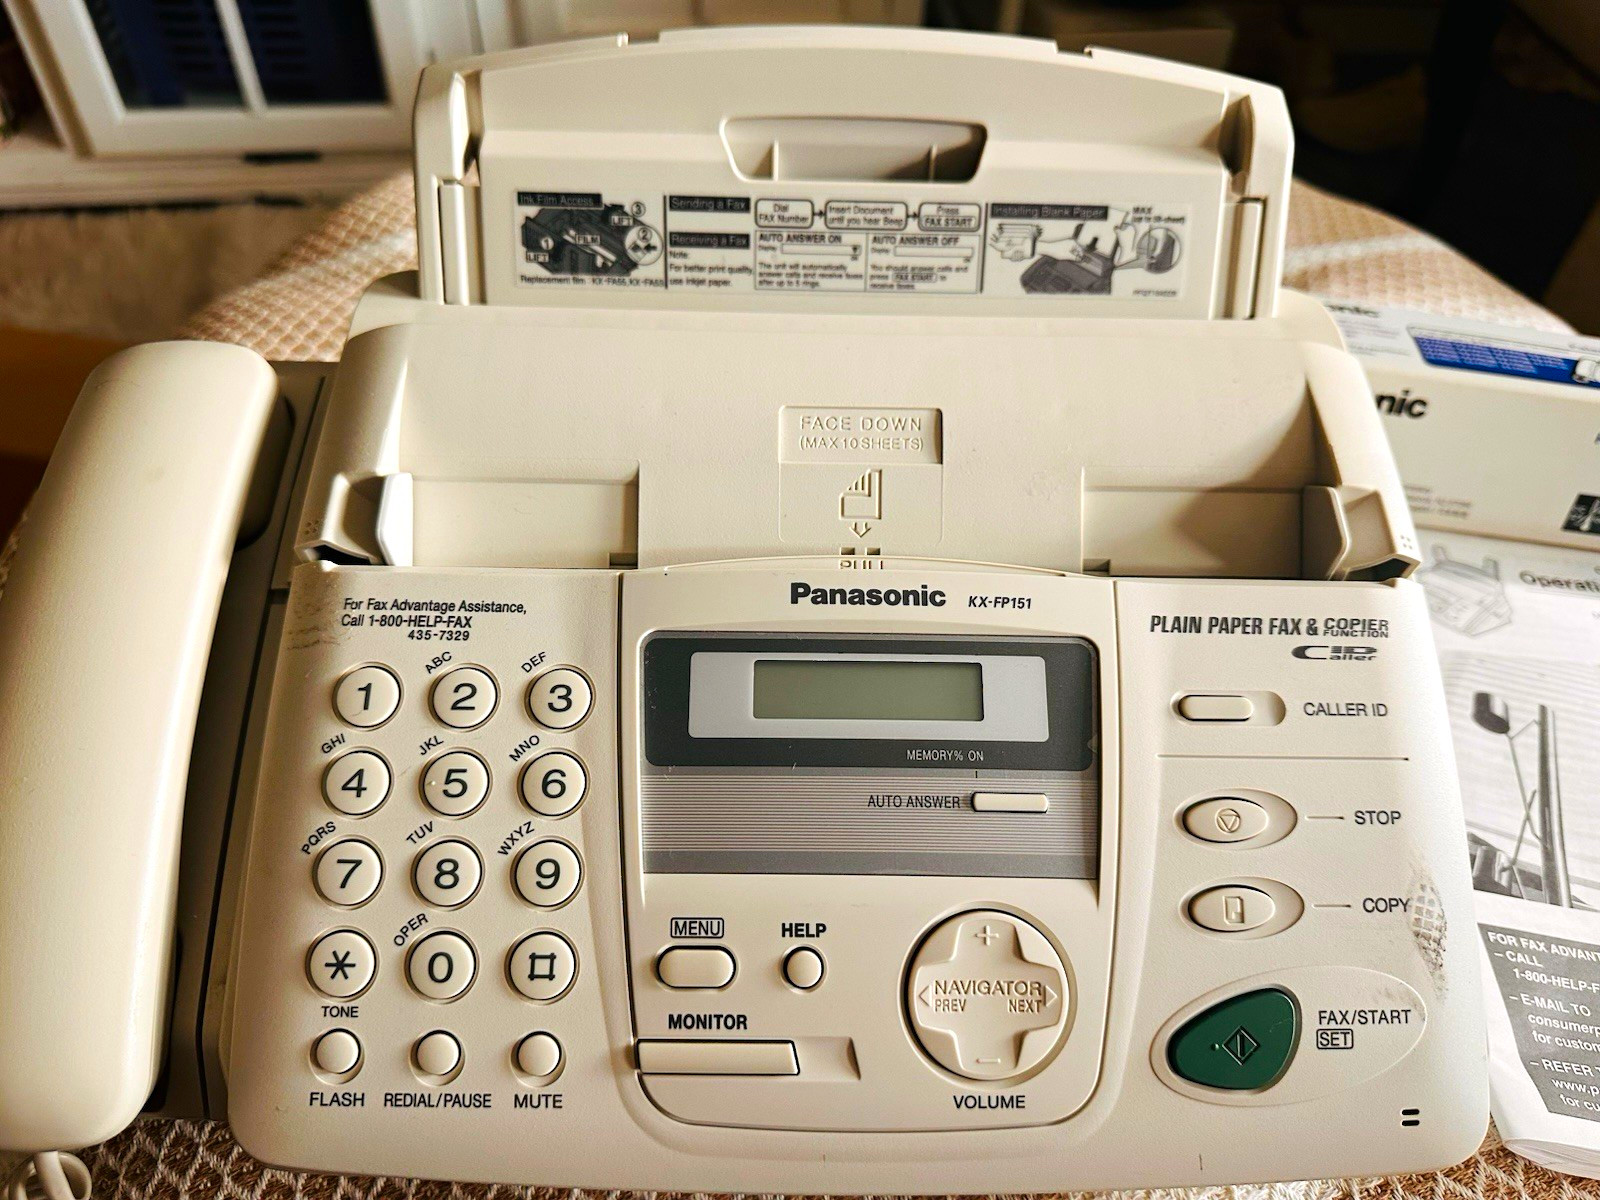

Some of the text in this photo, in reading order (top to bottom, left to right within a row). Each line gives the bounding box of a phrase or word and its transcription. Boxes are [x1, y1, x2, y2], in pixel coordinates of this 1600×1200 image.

[671, 198, 715, 211] Sending
[727, 200, 746, 209] Fax
[773, 203, 790, 212] Dial
[828, 206, 894, 215] Insert Document
[936, 206, 960, 215] Press
[611, 216, 633, 226] LIFT
[759, 214, 809, 223] FAX Number
[994, 206, 1039, 219] Installing
[1073, 207, 1106, 220] Paper
[828, 216, 845, 225] until
[847, 218, 861, 227] you
[863, 217, 882, 225] hear
[924, 218, 973, 227] FAX START
[576, 235, 601, 244] FILM
[758, 233, 842, 243] AUTO ANSWER ON
[871, 236, 960, 246] AUTO ANSWER OFF
[527, 253, 548, 262] LIFT
[800, 416, 922, 432] FACE DOWN
[842, 438, 858, 450] 10
[790, 582, 1032, 610] Panasonic KX-FP151
[343, 598, 527, 615] For Fax Advantage Assistance,
[341, 614, 473, 629] Call 1-800-HELP-FAX
[1150, 615, 1389, 636] PLAIN PAPER FAX & COPIER
[408, 629, 470, 641] 435-7329
[1323, 629, 1389, 638] FUNCTION
[424, 650, 453, 675] ABC
[520, 650, 549, 674] DEF
[357, 682, 373, 711] 1
[450, 682, 478, 711] 2
[547, 684, 573, 713] 3
[1303, 702, 1389, 717] CALLER ID
[320, 733, 347, 755] GHI
[418, 735, 445, 757] JKL
[508, 734, 541, 762] MNO
[906, 750, 985, 762] MEMORY% ON
[341, 768, 368, 798] 4
[442, 768, 468, 798] 5
[541, 768, 567, 799] 6
[867, 795, 961, 809] AUTO ANSWER
[1354, 810, 1402, 825] STOP
[301, 820, 337, 856] PQRS
[405, 820, 436, 846] TUV
[496, 820, 536, 857] WXYZ
[336, 858, 363, 889] 7
[433, 858, 460, 890] 8
[535, 858, 561, 890] 9
[1362, 897, 1411, 913] COPY
[393, 911, 430, 948] OPER
[673, 920, 722, 936] MENU
[781, 923, 827, 938] HELP
[1487, 931, 1600, 962] FOR FAX ADVANT
[427, 951, 454, 984] 0
[1505, 951, 1544, 968] CALL
[934, 979, 1043, 997] NAVIGATOR
[1513, 967, 1600, 994] 1-800-HELP-F
[321, 1005, 359, 1019] TONE
[934, 998, 967, 1014] PREV
[1008, 998, 1043, 1014] NEXT
[1520, 993, 1592, 1017] E-MAIL TO
[668, 1013, 749, 1031] MONITOR
[1318, 1009, 1412, 1026] FAX/START
[1527, 1013, 1600, 1038] consumerp
[1319, 1032, 1351, 1047] SET
[1532, 1030, 1552, 1044] for
[1541, 1058, 1594, 1077] REFER
[309, 1092, 365, 1107] FLASH
[383, 1093, 492, 1109] REDIAL/PAUSE
[513, 1094, 563, 1109] MUTE
[953, 1095, 1025, 1110] VOLUME
[1559, 1093, 1580, 1108] for
